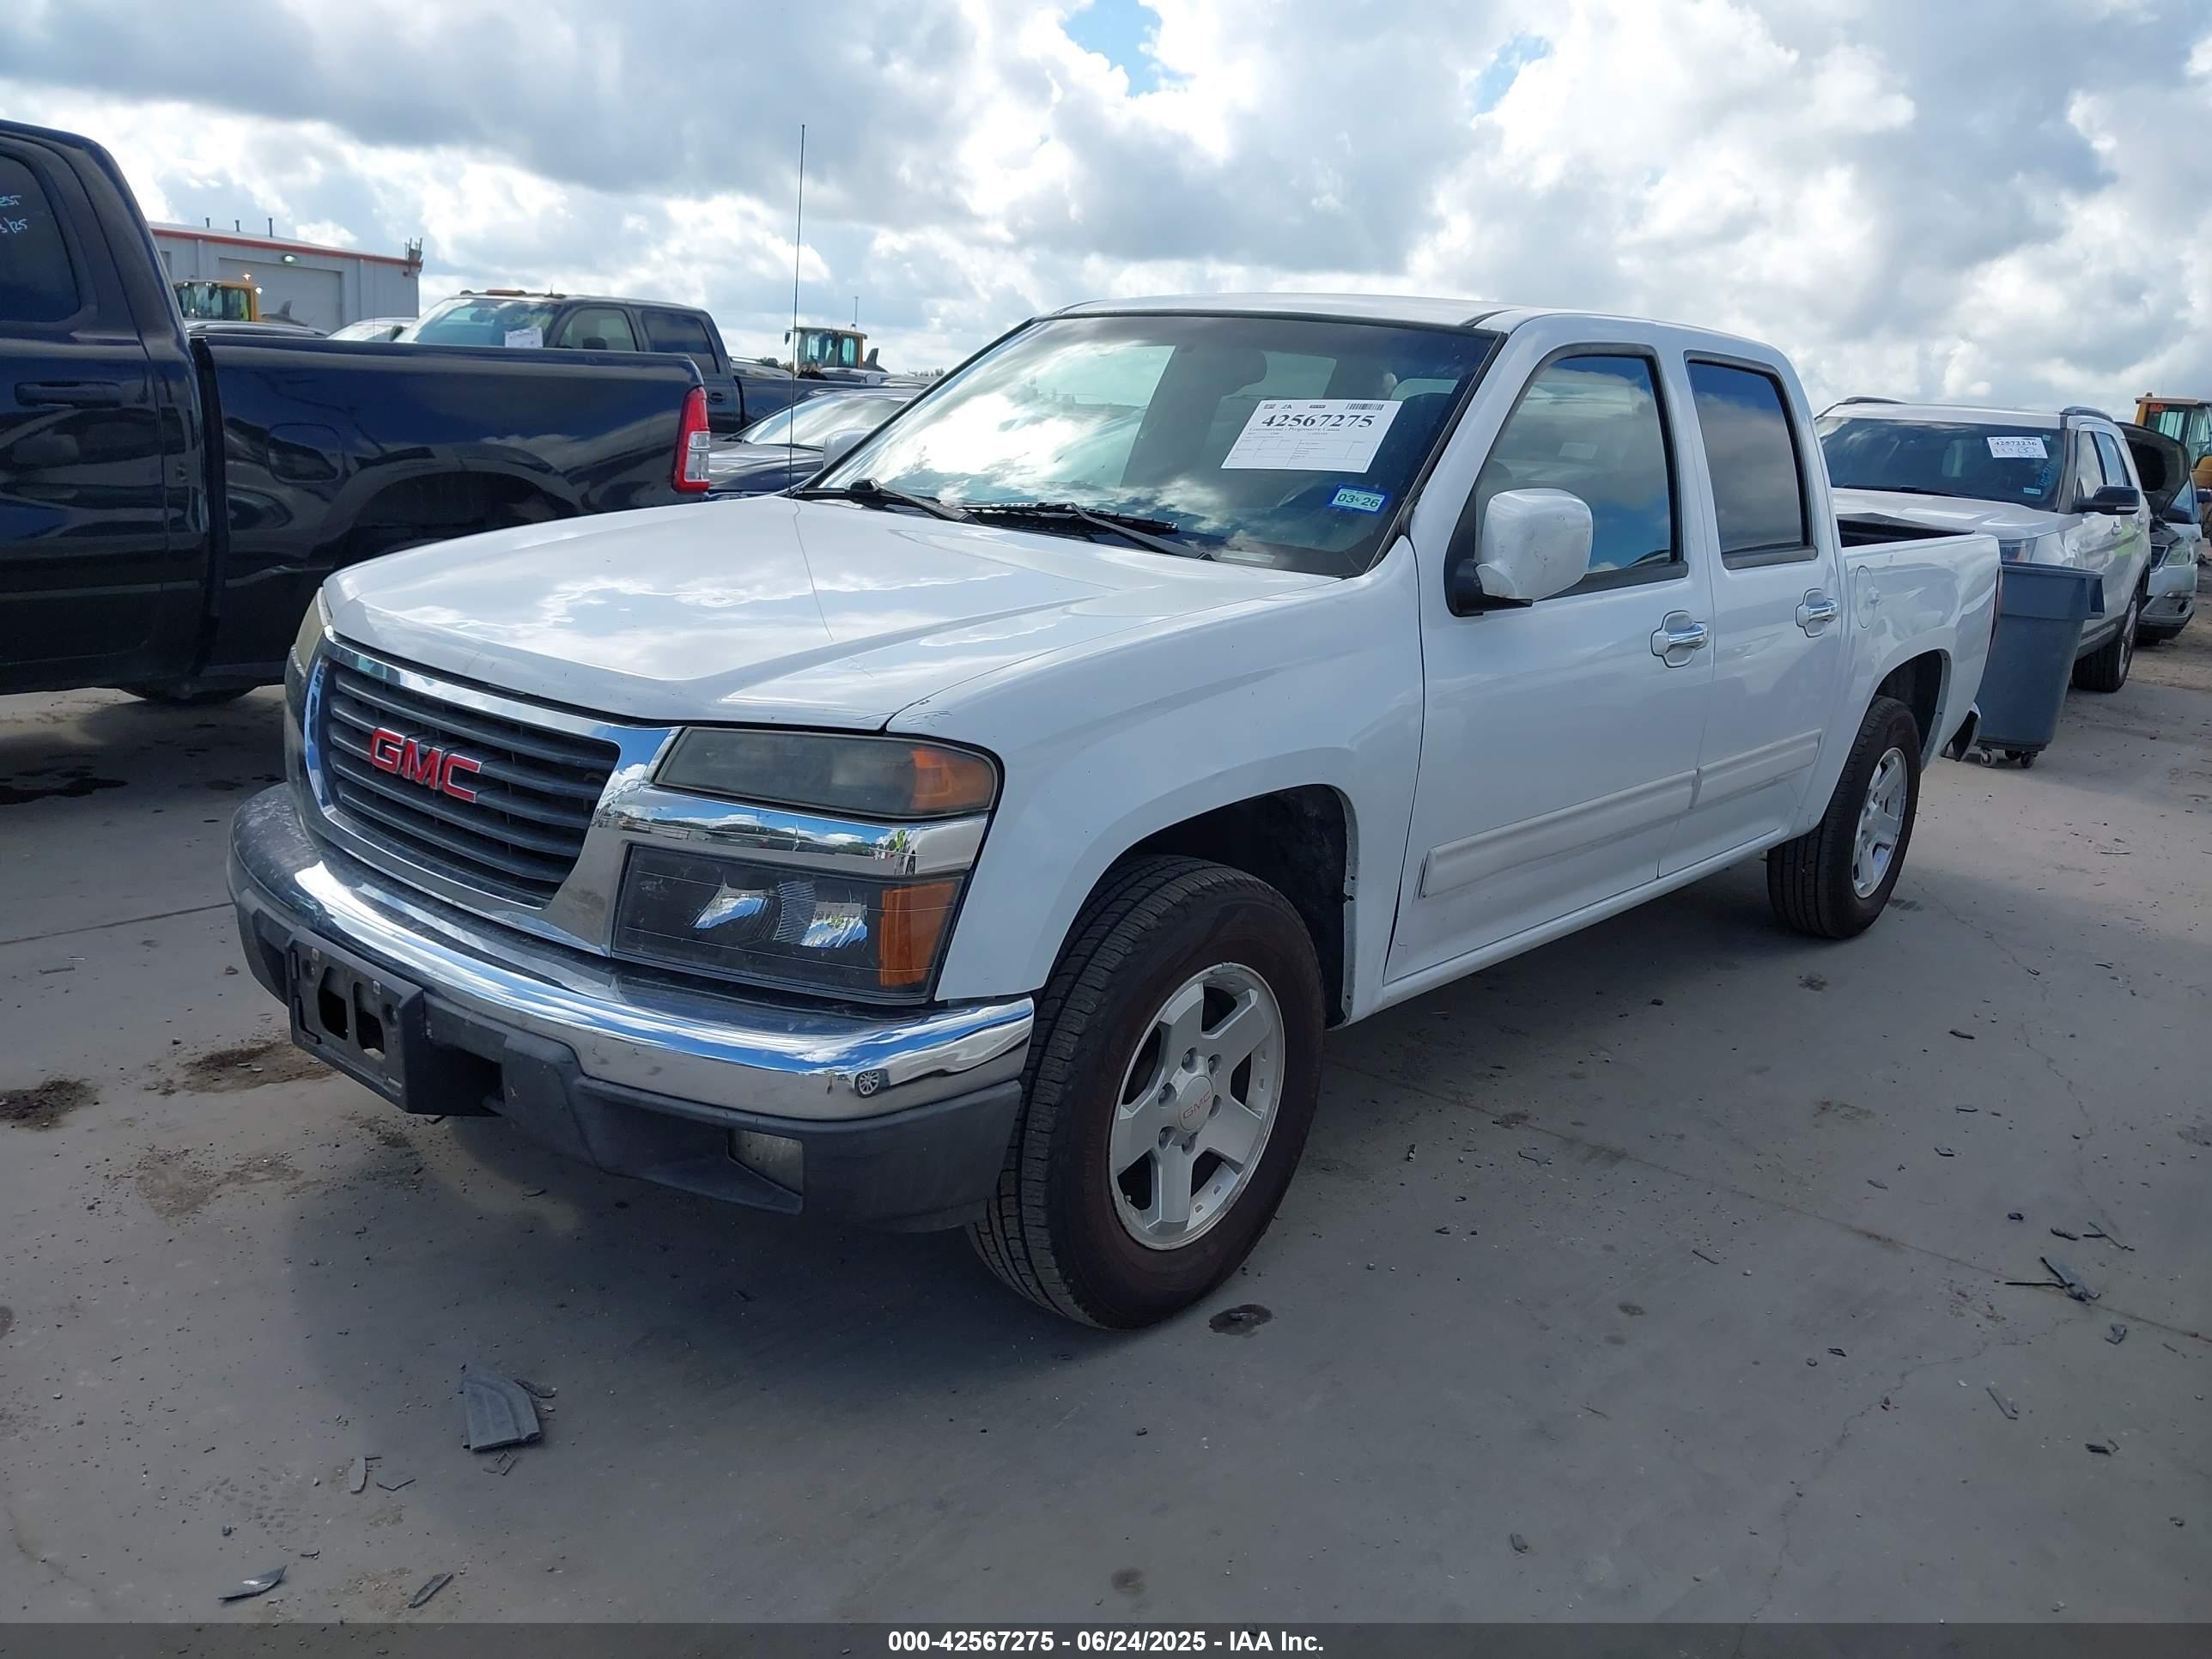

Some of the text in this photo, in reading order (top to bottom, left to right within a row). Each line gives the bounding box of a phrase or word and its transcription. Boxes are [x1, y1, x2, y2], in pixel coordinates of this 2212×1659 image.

[1261, 414, 1376, 428] 42567275
[1337, 493, 1380, 507] 03 26
[370, 726, 483, 804] GMC
[1183, 1091, 1211, 1119] GMC
